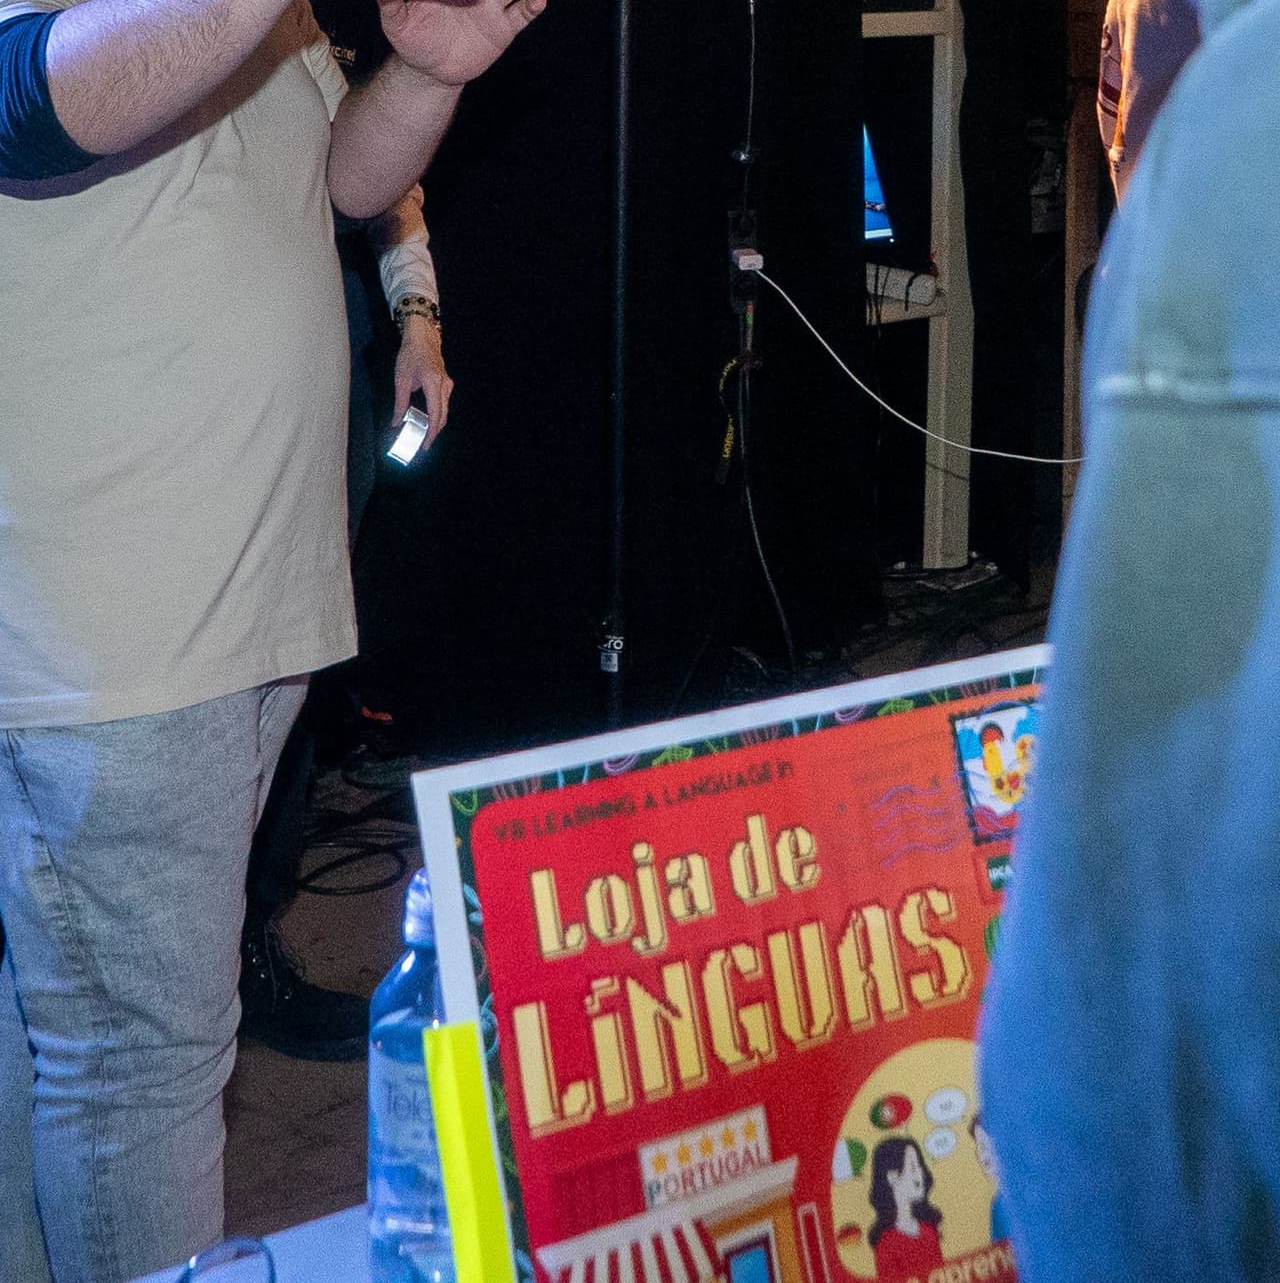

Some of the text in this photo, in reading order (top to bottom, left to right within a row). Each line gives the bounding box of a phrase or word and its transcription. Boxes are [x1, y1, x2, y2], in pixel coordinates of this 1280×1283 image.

[532, 792, 637, 838] LEARNING
[643, 791, 658, 811] A
[663, 760, 772, 808] LANGUAGE
[529, 814, 822, 960] Loja de
[646, 1142, 768, 1209] PORTUGAL
[928, 1243, 1017, 1283] apren
